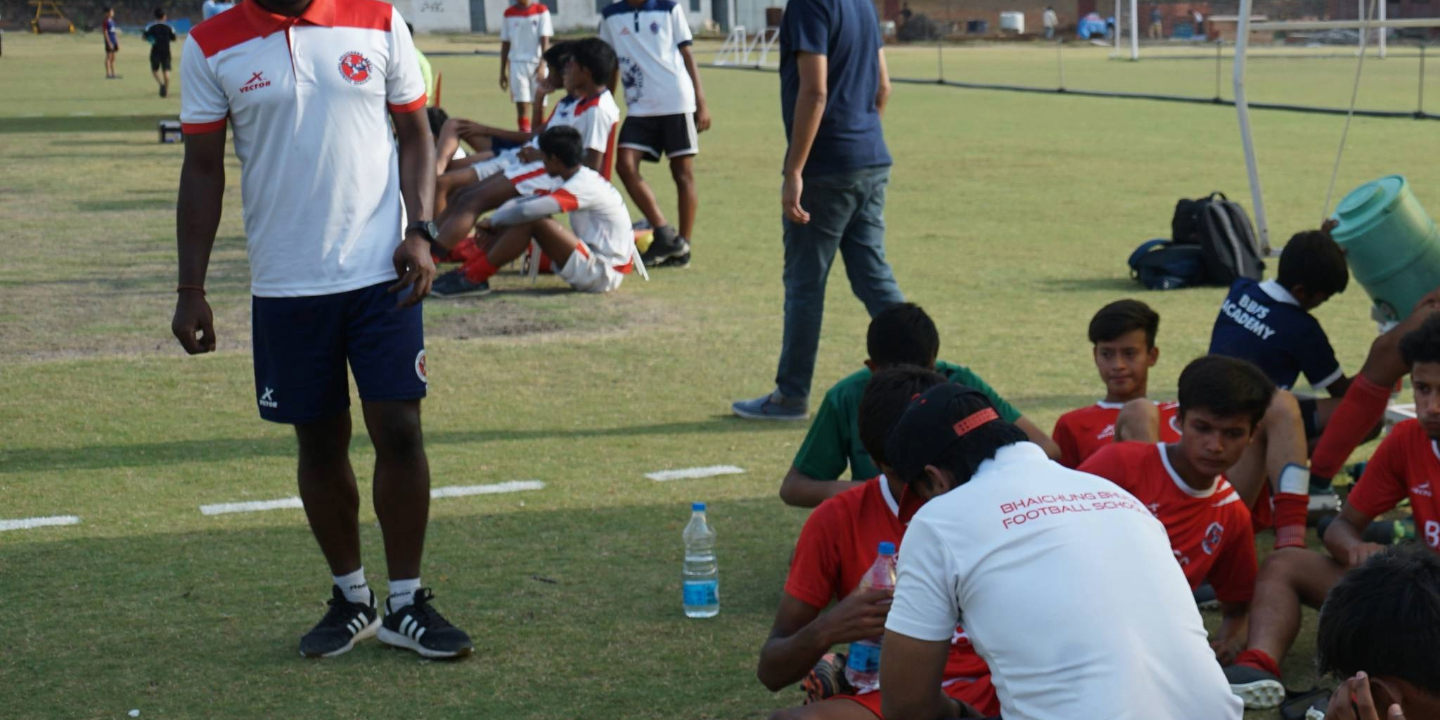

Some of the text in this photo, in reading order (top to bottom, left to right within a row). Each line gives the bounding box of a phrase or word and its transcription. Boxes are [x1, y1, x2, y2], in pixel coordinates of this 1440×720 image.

[239, 81, 271, 93] VECTOR
[1000, 493, 1096, 514] BHAICHUNG
[1002, 501, 1146, 530] FOOTBALL SCHOO
